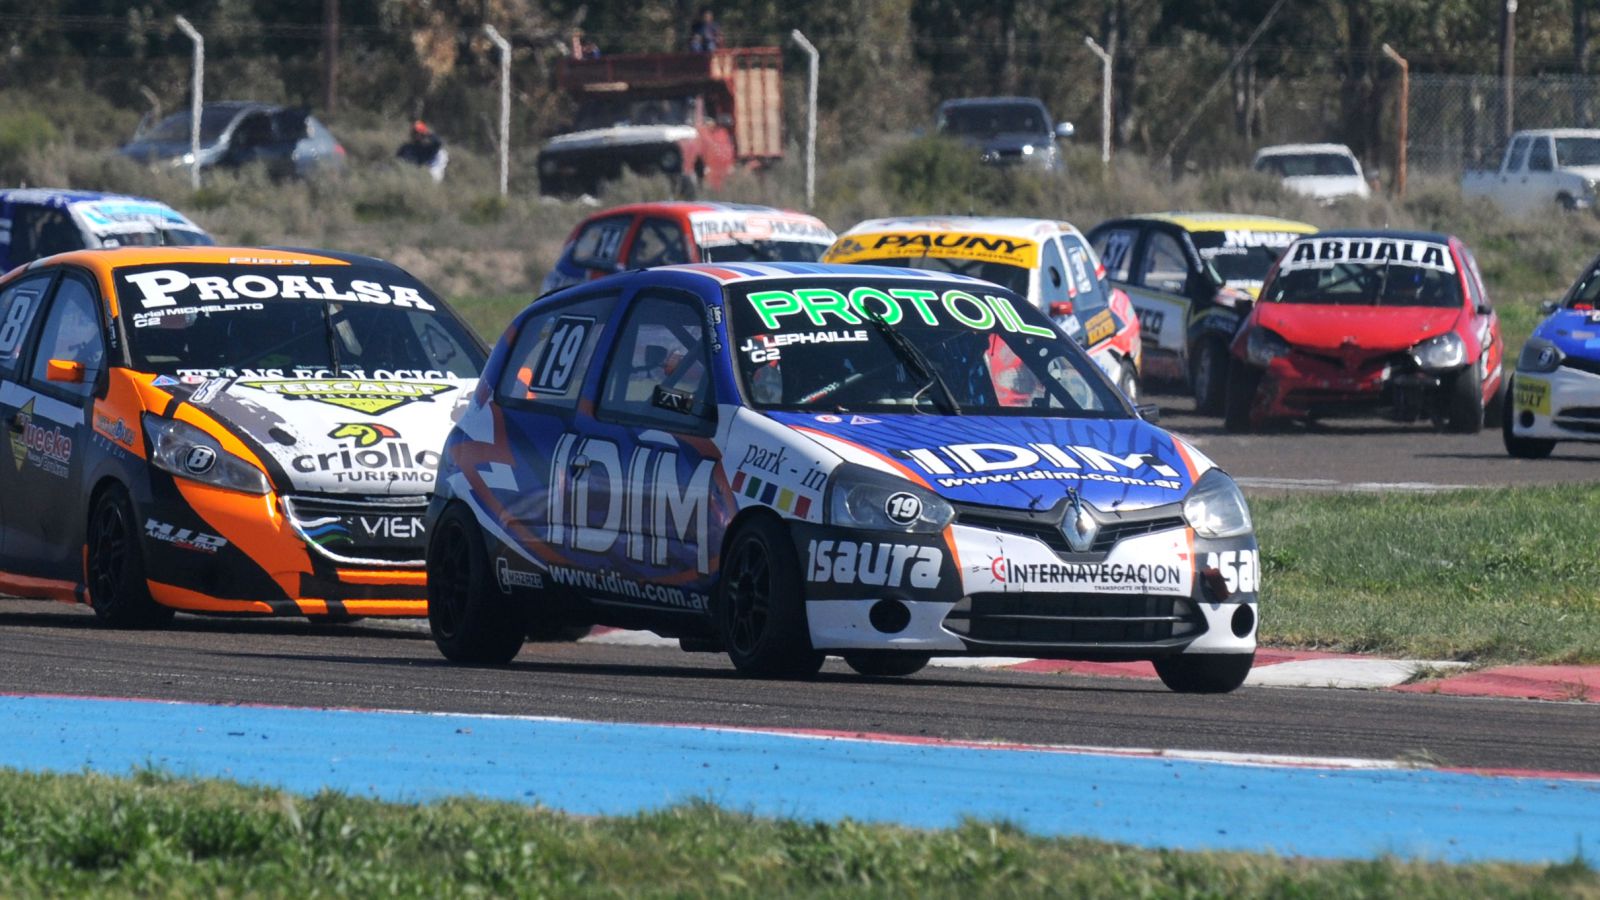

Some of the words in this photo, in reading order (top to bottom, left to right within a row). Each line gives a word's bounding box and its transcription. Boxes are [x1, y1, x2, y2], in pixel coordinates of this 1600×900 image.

[873, 234, 1032, 253] PAUNY
[1291, 241, 1445, 267] ABDALA
[0, 295, 31, 352] 8
[132, 310, 165, 321] Ariel
[166, 302, 264, 316] MICHIELETTO
[134, 317, 161, 328] C2
[746, 287, 1056, 339] PROTOIL
[740, 339, 758, 352] J.
[763, 330, 869, 348] LEPHAILLE
[537, 323, 586, 390] 19
[751, 348, 781, 363] C2
[292, 368, 458, 380] ECLOGICA
[188, 448, 212, 468] 8
[292, 443, 441, 473] criollo
[736, 443, 787, 475] park
[800, 460, 828, 492] in
[901, 443, 1180, 477] IDIM
[333, 471, 434, 483] TURISMO
[937, 470, 1182, 490] www.idim.com.ar
[546, 433, 717, 575] IDIM
[891, 497, 918, 518] 19
[1007, 558, 1180, 584] INTERNAVEGACION
[548, 564, 711, 610] www.idim.com.ar
